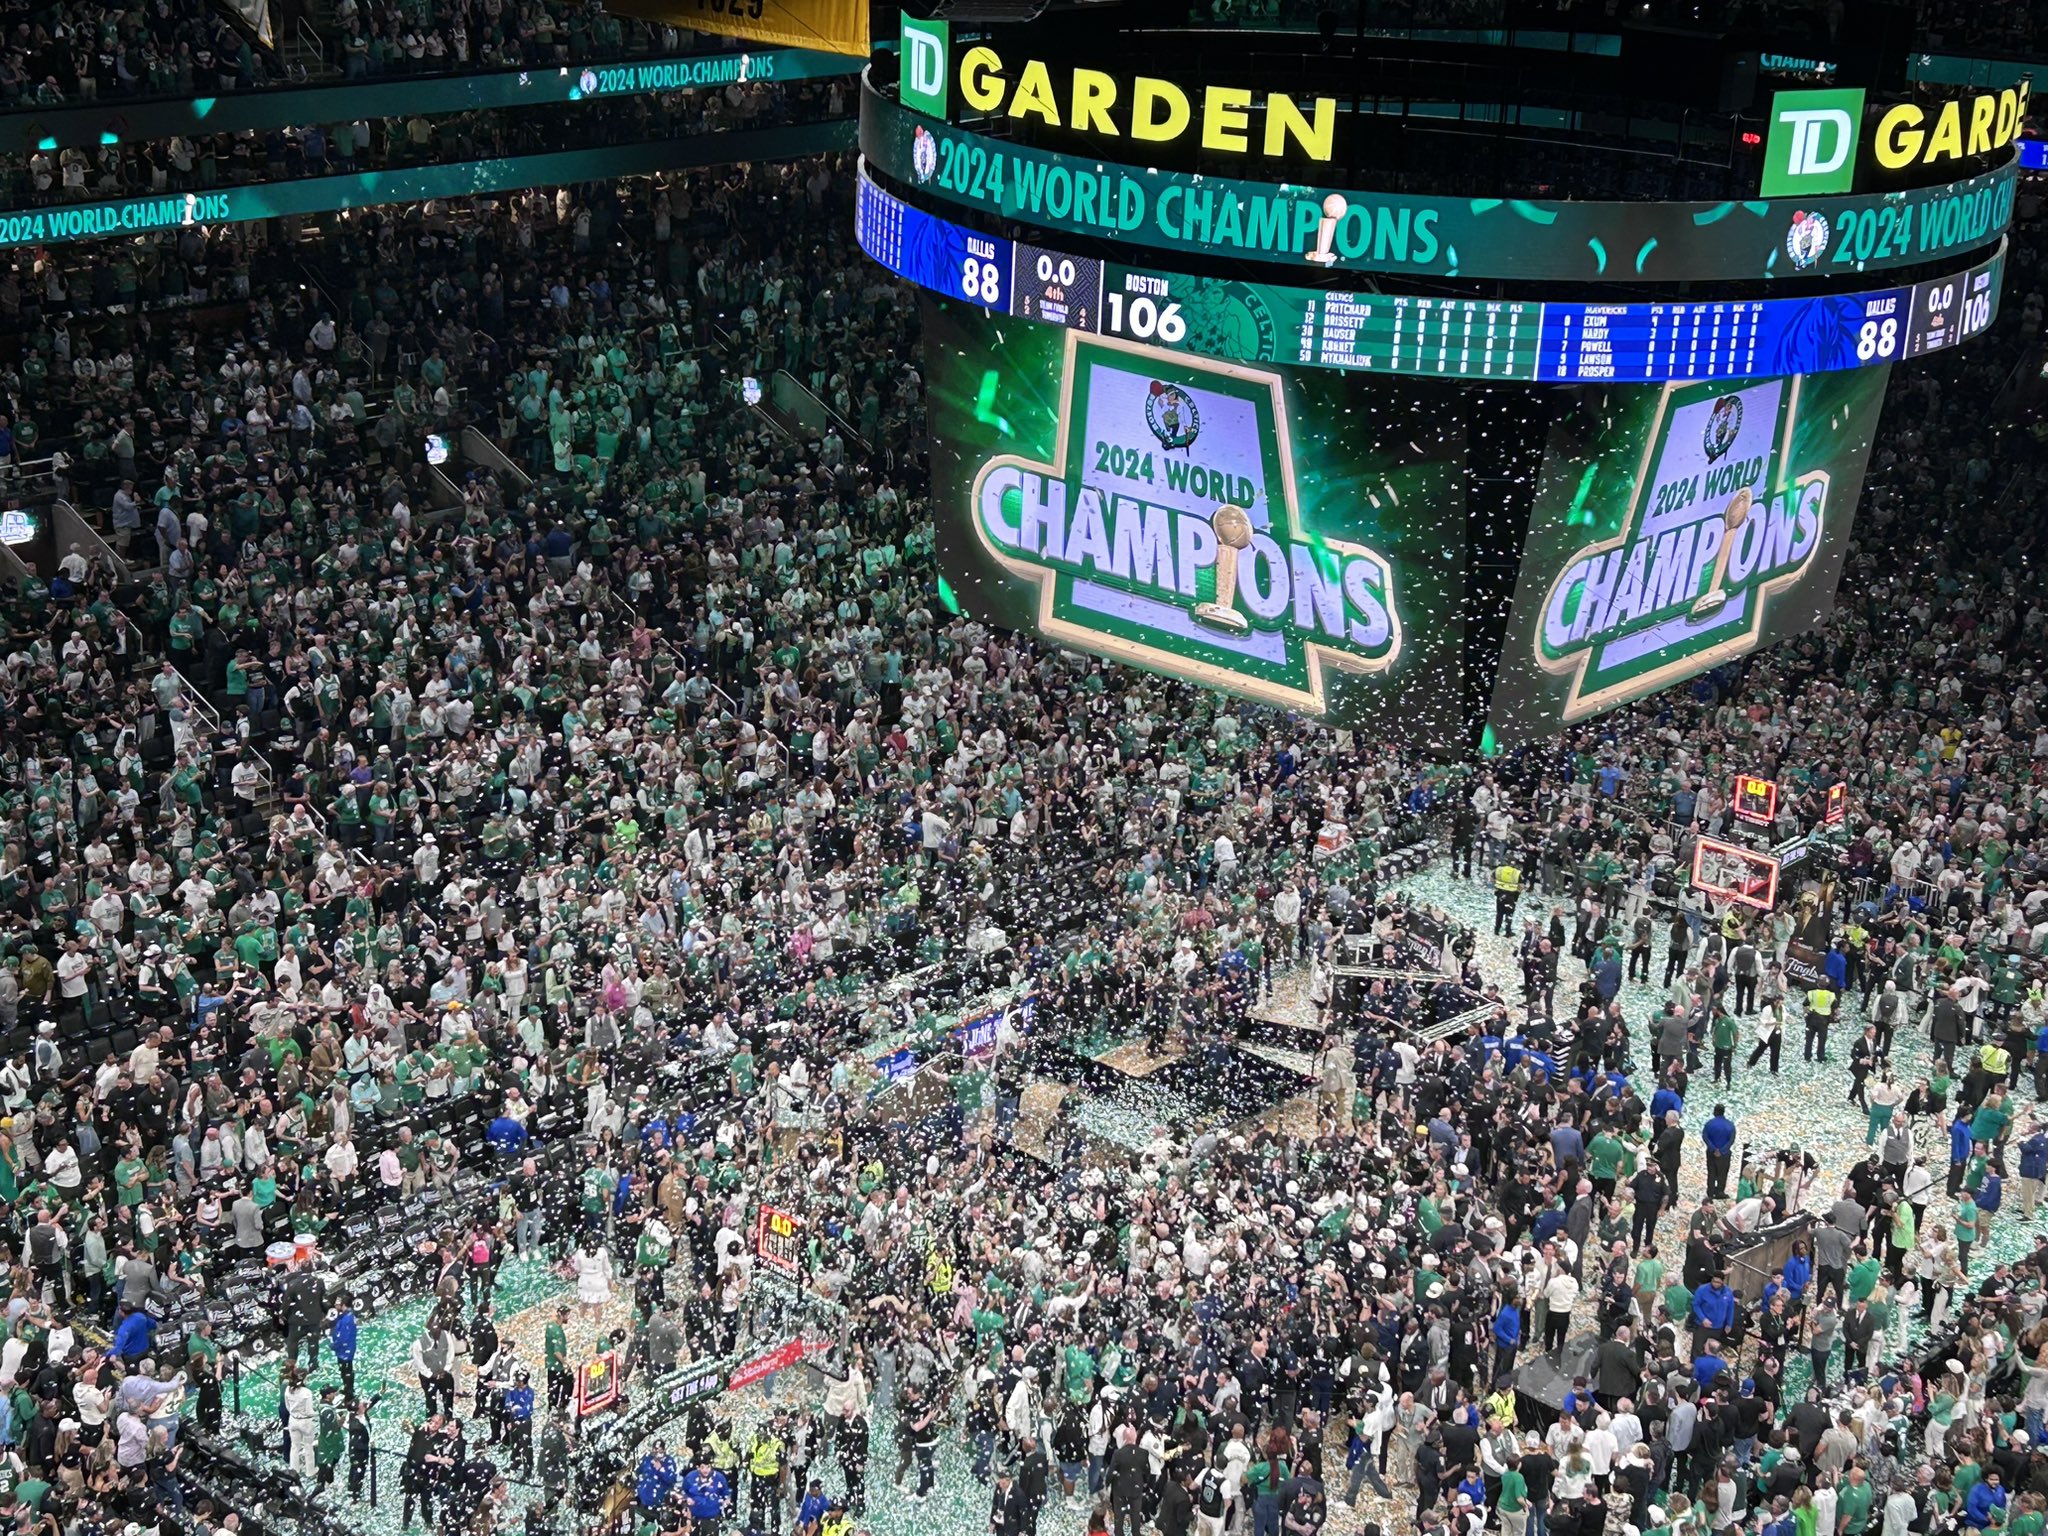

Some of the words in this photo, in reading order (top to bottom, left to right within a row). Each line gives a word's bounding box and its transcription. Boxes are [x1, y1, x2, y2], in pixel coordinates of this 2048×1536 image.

[600, 68, 635, 92] 2024
[638, 64, 689, 89] WORLD
[693, 55, 774, 83] CHAMPIONS
[905, 26, 943, 96] TD
[960, 47, 1336, 161] GARDEN
[1779, 109, 1852, 176] TD
[0, 215, 44, 243] 2024
[48, 207, 118, 237] WORLD
[122, 194, 229, 229] CHAMPIONS
[940, 137, 1003, 203] 2024
[1013, 157, 1145, 231] WORLD
[1156, 185, 1439, 264] CHAMPIONS
[1832, 205, 1912, 262] 2024
[1920, 188, 1992, 252] WORLD
[962, 257, 999, 303] 88
[1037, 255, 1075, 286] 0.0
[1125, 273, 1168, 296] BOSTON
[1045, 286, 1064, 301] 4th
[1866, 297, 1896, 317] DALLAS
[1928, 284, 1953, 312] 0.0
[1962, 290, 1990, 335] 106
[1108, 292, 1186, 342] 106
[1324, 314, 1365, 329] BRISSETT
[1582, 328, 1609, 339] HARDY
[1583, 316, 1607, 326] EXUM
[1581, 341, 1612, 352] POWELL
[1857, 318, 1897, 360] 88
[1578, 366, 1615, 377] PROSPER
[1579, 353, 1612, 365] LAWSON
[1094, 440, 1155, 486] 2024
[1165, 457, 1255, 510] WORLD
[1654, 478, 1697, 518] 2024
[1703, 455, 1763, 502] WORLD
[980, 466, 1391, 648] CHAMPIONS
[1544, 483, 1823, 648] CHAMPIONS
[1747, 780, 1766, 796] 0.0
